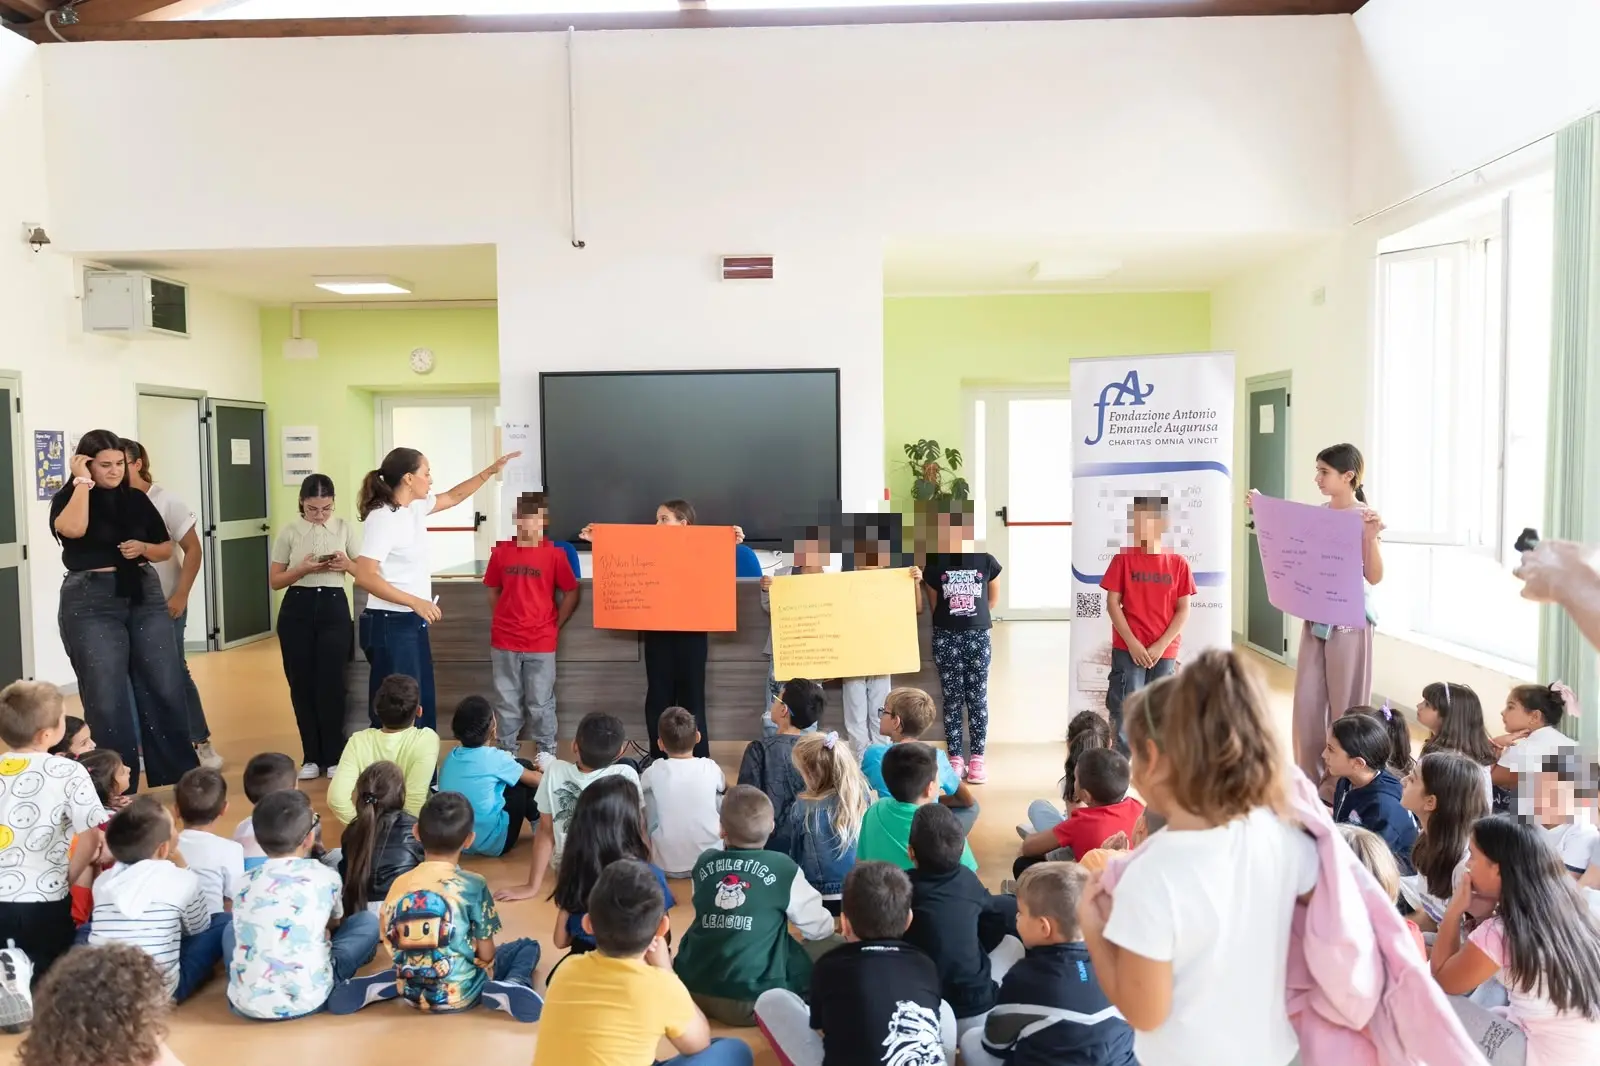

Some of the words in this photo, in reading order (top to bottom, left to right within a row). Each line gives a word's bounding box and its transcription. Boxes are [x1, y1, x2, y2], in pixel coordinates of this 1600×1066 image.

[1109, 409, 1170, 422] Fondazione
[1172, 408, 1217, 420] Antonio
[1109, 422, 1162, 434] Emanuele
[1164, 421, 1218, 436] Augurusa
[1187, 437, 1219, 445] VINCIT
[1131, 571, 1172, 584] HUGO
[700, 859, 777, 886] ATHLETICS
[702, 914, 753, 931] LEAGUE
